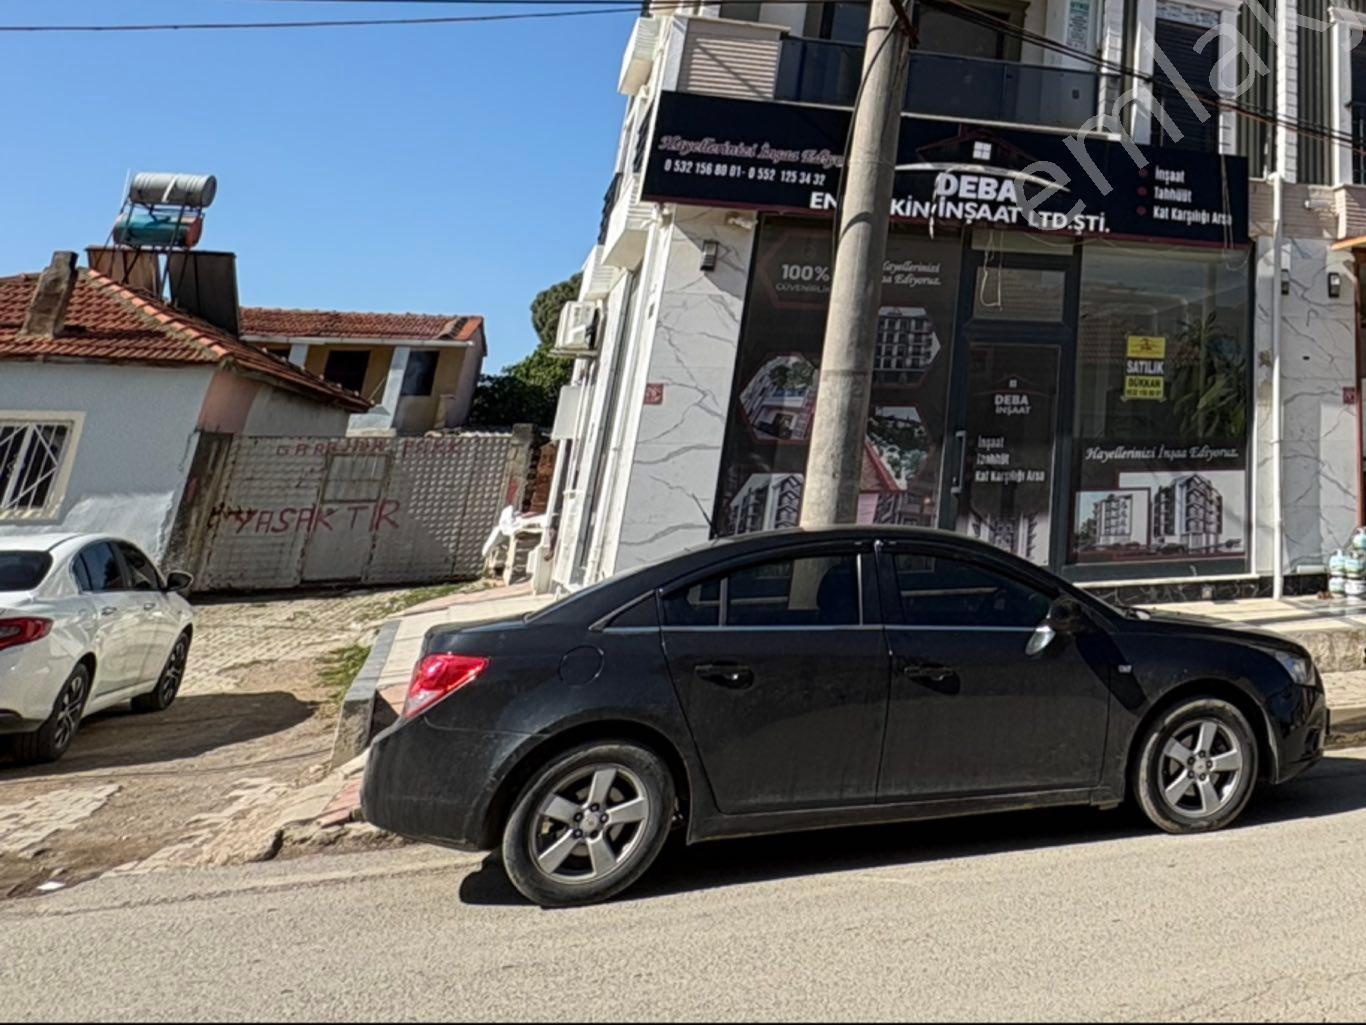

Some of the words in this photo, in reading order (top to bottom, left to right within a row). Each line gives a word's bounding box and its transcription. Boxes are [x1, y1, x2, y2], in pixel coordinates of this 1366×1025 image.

[664, 158, 672, 172] 0
[673, 160, 692, 174] 532
[695, 162, 712, 176] 156
[714, 164, 727, 177] 80
[748, 166, 755, 179] 0
[757, 167, 776, 182] 552
[781, 169, 798, 183] 125
[799, 171, 812, 185] 34
[813, 173, 827, 186] 32
[936, 173, 1018, 202] DEBA
[938, 197, 1023, 225] İNŞAAT
[1152, 205, 1170, 220] Kat
[1211, 212, 1233, 226] Arsa
[781, 263, 830, 283] 100%
[1126, 360, 1165, 375] SATILIK
[994, 394, 1029, 406] DEBA
